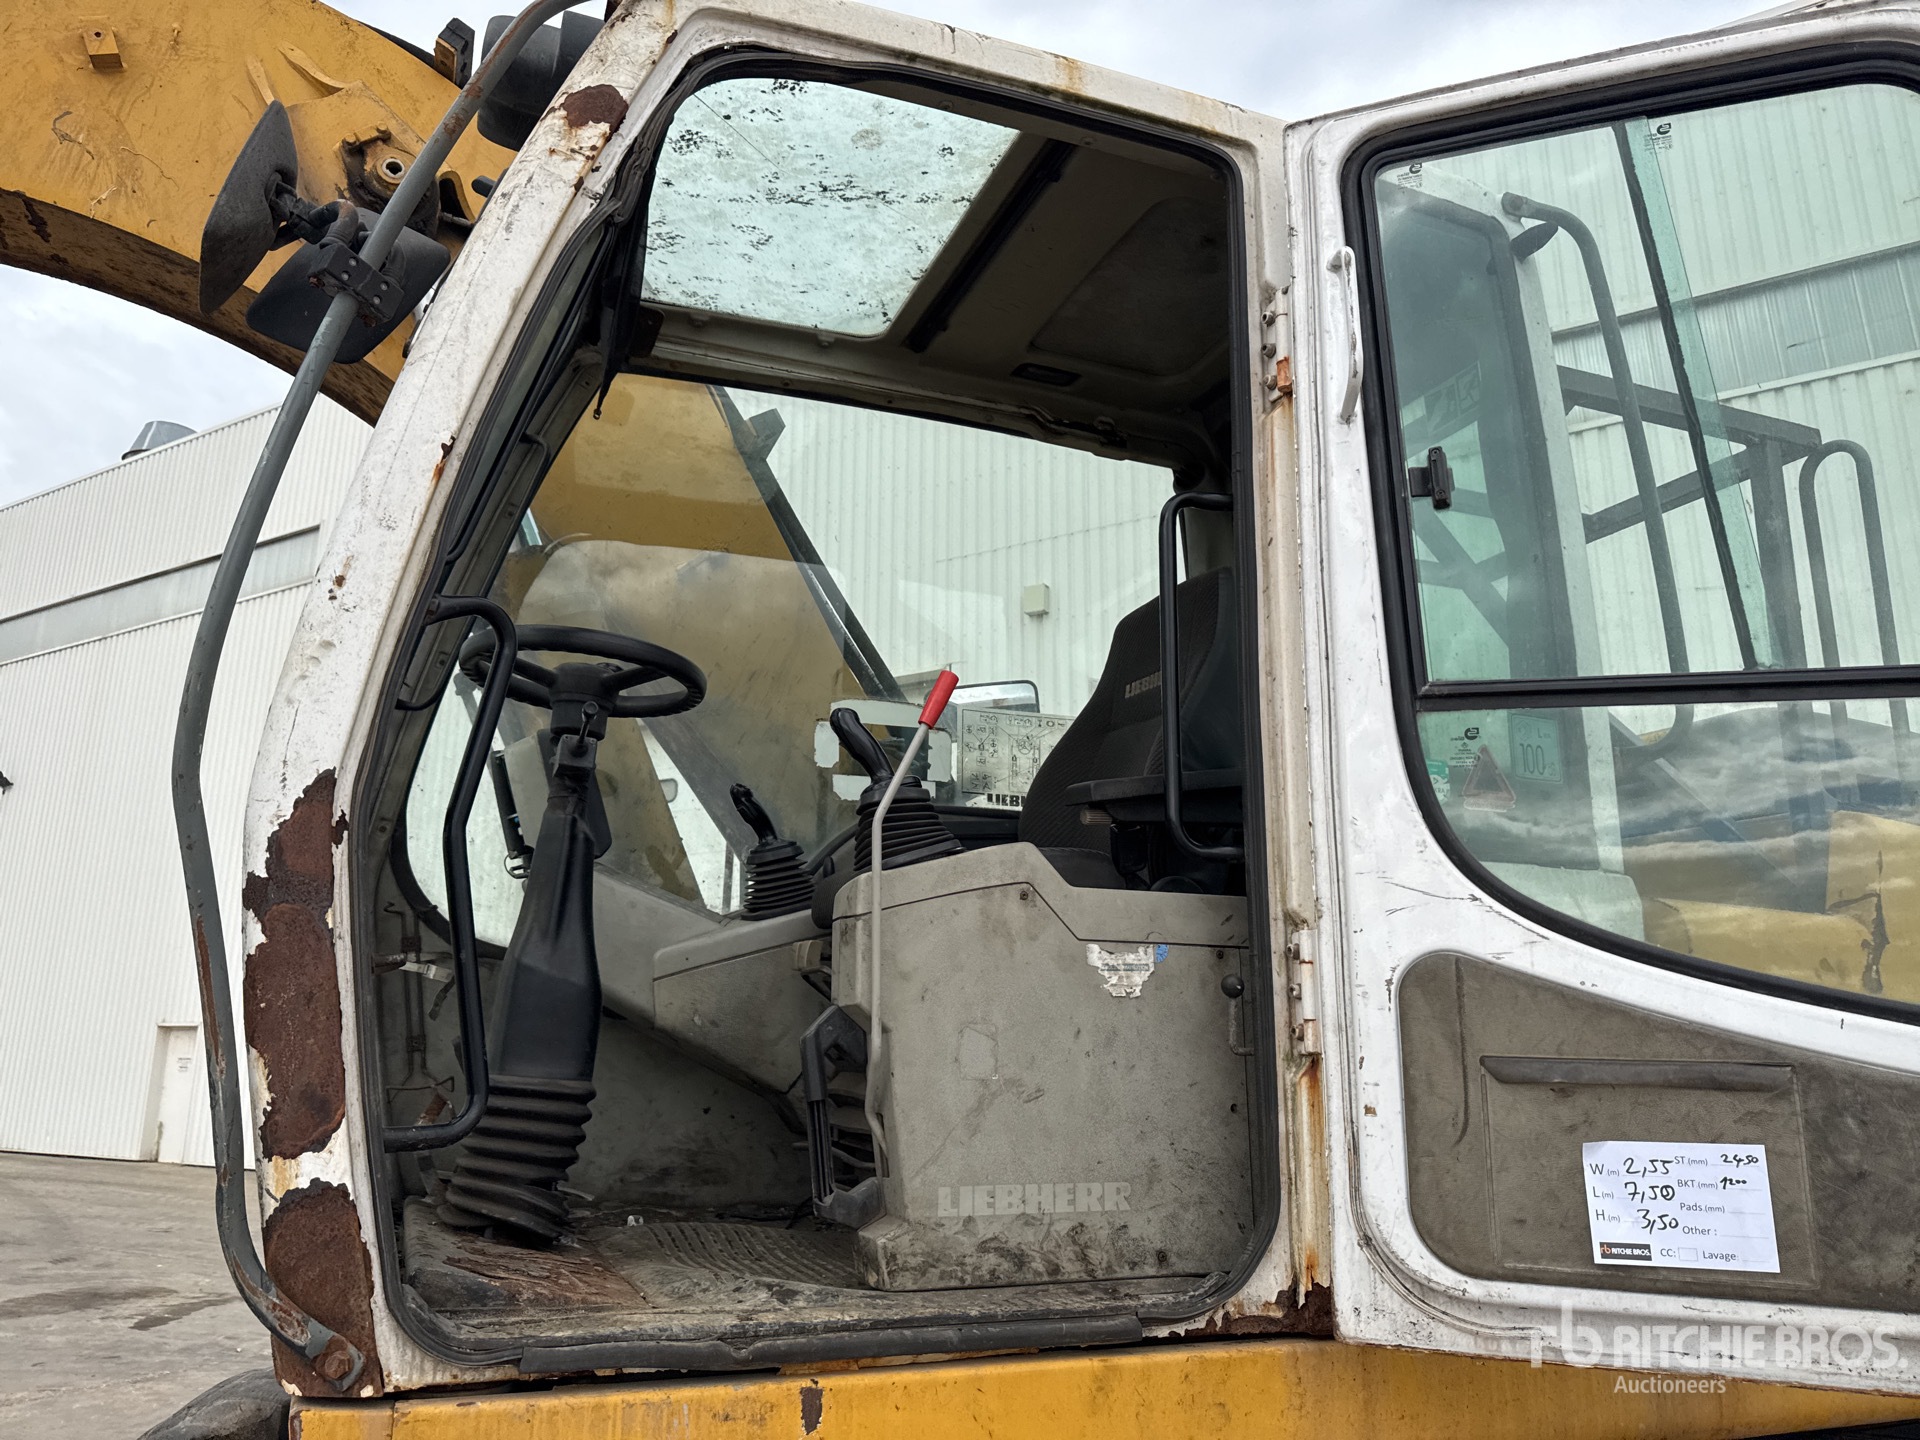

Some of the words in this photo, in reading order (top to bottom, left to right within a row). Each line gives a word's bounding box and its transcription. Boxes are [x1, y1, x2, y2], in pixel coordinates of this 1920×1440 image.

[1519, 743, 1546, 775] 100
[1674, 1156, 1685, 1165] ST
[1720, 1153, 1759, 1168] 2450
[1590, 1163, 1604, 1175] W
[1623, 1157, 1674, 1178] 2,55
[1677, 1178, 1695, 1188] BKT
[1592, 1186, 1600, 1198] L
[937, 1181, 1132, 1217] LIEBHERR
[1595, 1209, 1606, 1221] H
[1636, 1208, 1679, 1235] 3,50
